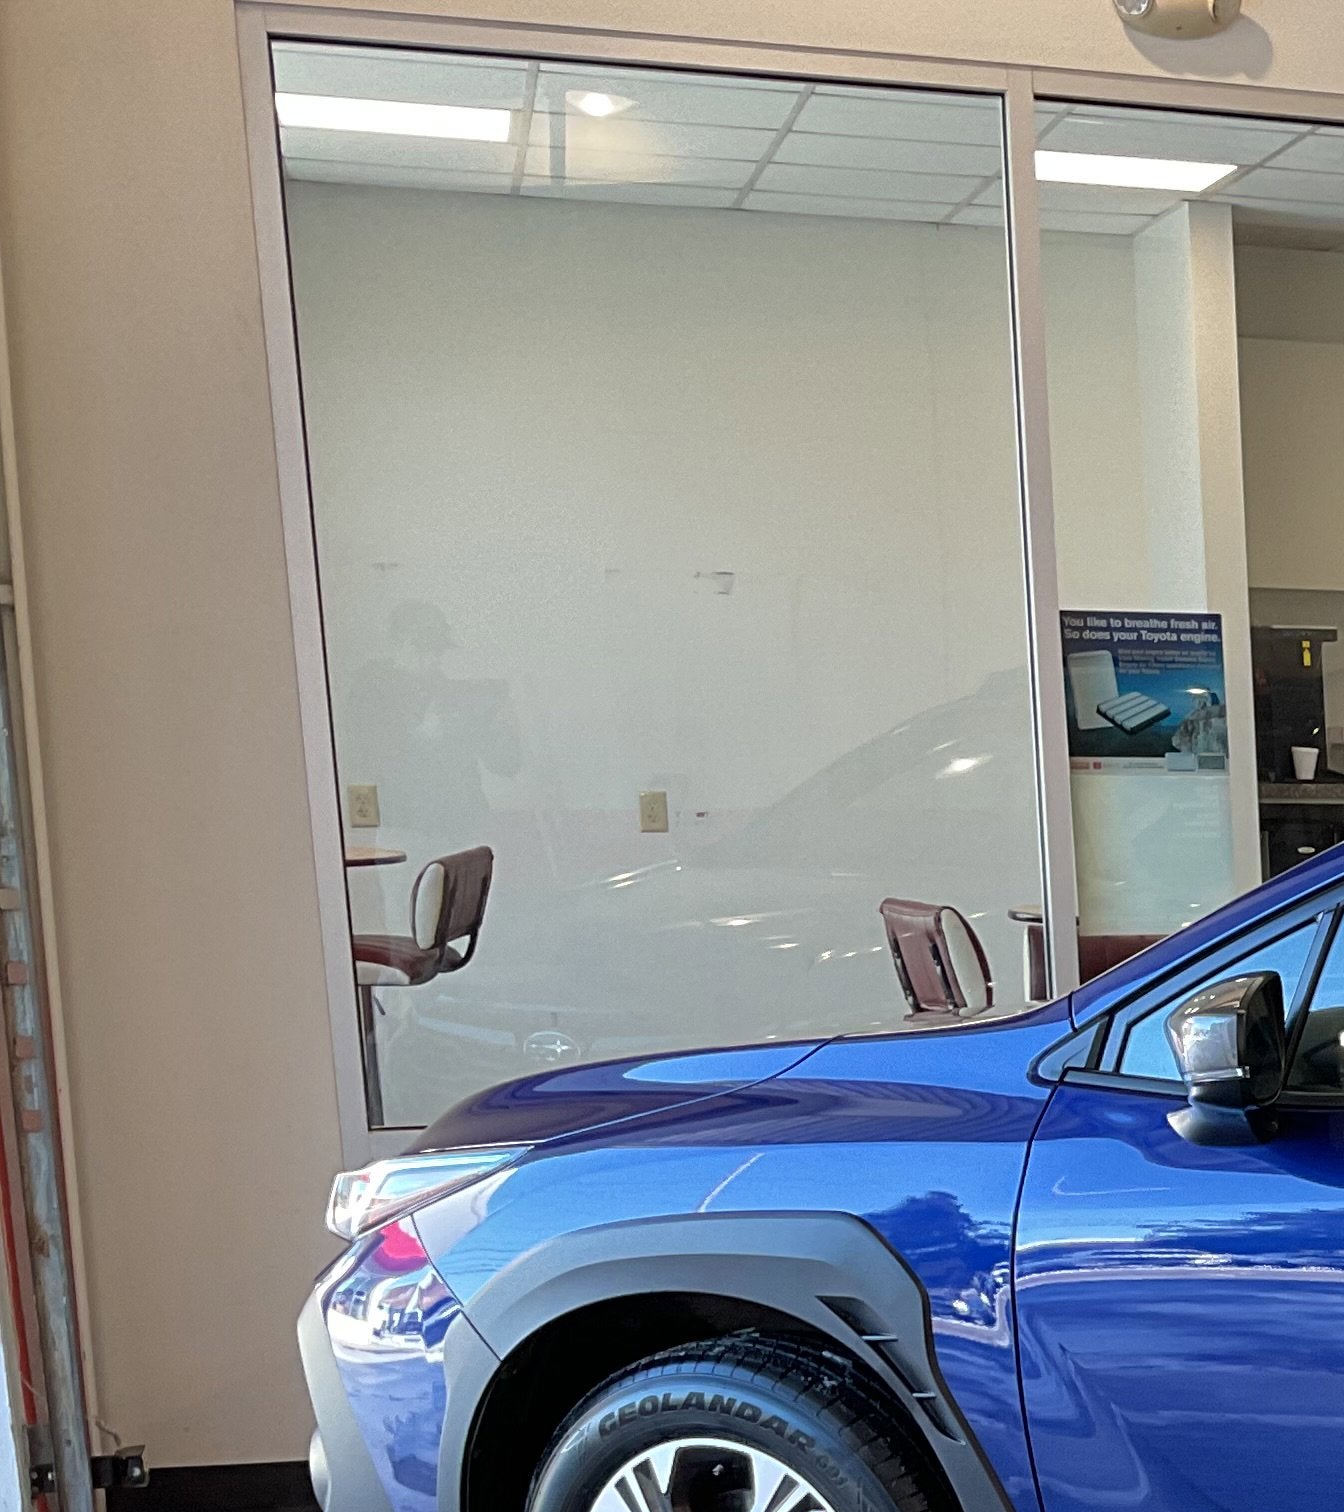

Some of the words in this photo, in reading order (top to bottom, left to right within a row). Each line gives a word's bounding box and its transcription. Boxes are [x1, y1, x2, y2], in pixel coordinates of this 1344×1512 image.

[1063, 616, 1084, 627] You
[1086, 616, 1107, 628] like
[1110, 618, 1122, 628] to
[1124, 617, 1168, 629] breathe
[1170, 618, 1199, 630] fresh
[1064, 628, 1080, 639] So
[1082, 629, 1111, 640] does
[1113, 630, 1138, 643] your
[1140, 630, 1178, 643] Toyota
[597, 1391, 817, 1455] GEOLANDAR
